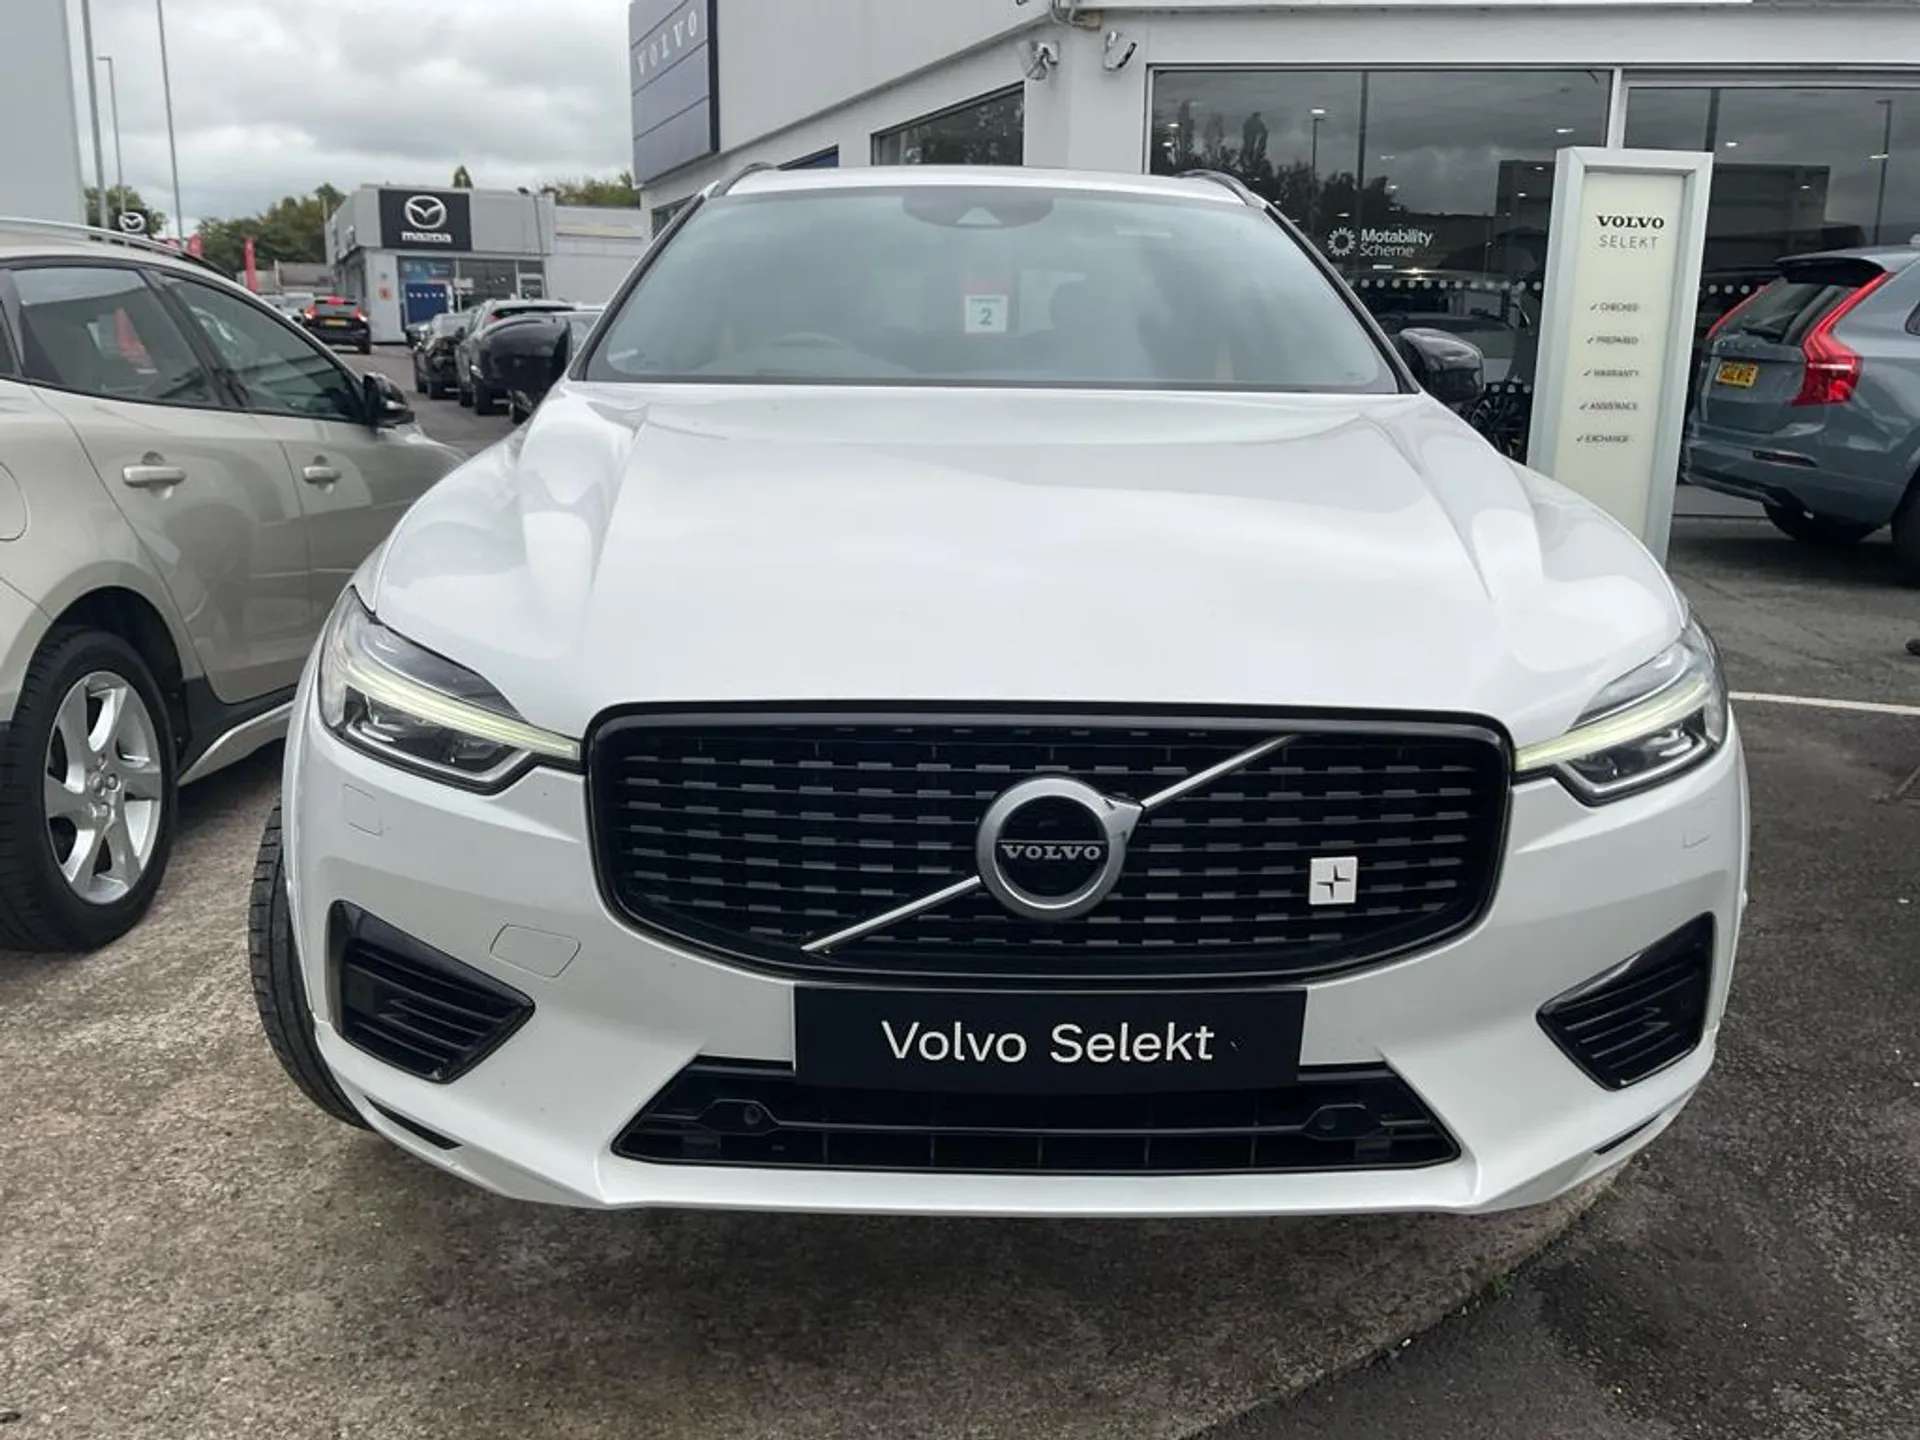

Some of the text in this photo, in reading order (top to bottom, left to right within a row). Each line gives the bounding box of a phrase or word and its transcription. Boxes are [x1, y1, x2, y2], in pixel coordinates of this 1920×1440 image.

[638, 9, 697, 76] VOLVO
[1597, 215, 1664, 229] VOLVO
[1361, 228, 1432, 248] Motability
[1599, 234, 1659, 249] SELEKT
[1360, 243, 1415, 257] Scheme
[979, 307, 992, 325] 2
[1001, 845, 1101, 860] VOLVO
[881, 1020, 1215, 1063] Volvo Selekt
